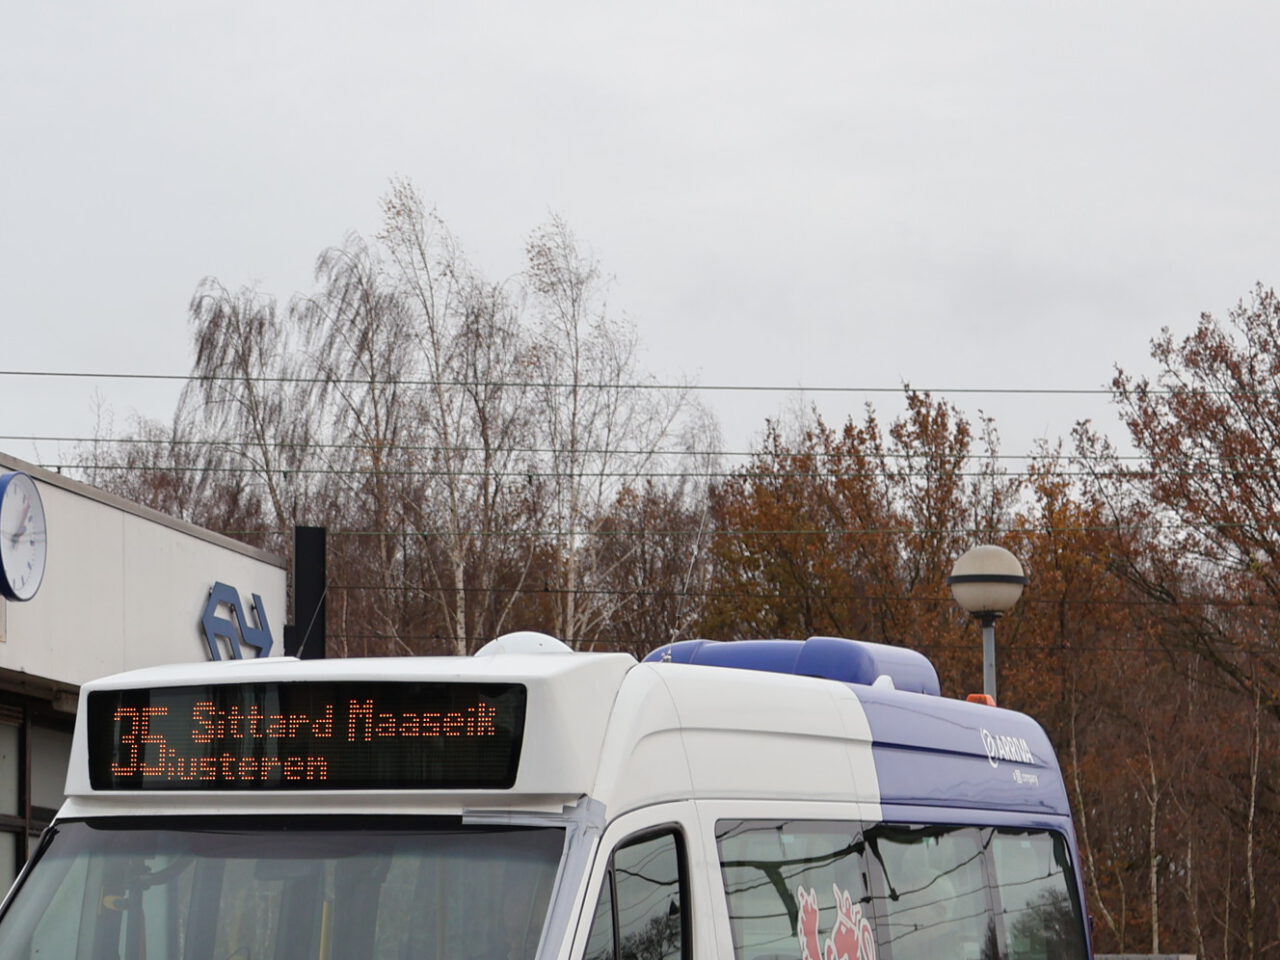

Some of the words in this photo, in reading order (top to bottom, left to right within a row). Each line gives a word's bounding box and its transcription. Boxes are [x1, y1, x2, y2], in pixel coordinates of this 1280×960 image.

[111, 706, 169, 777] 35
[192, 701, 334, 744] Sittard
[347, 699, 497, 742] Maaseik
[995, 735, 1035, 764] ARRIVA
